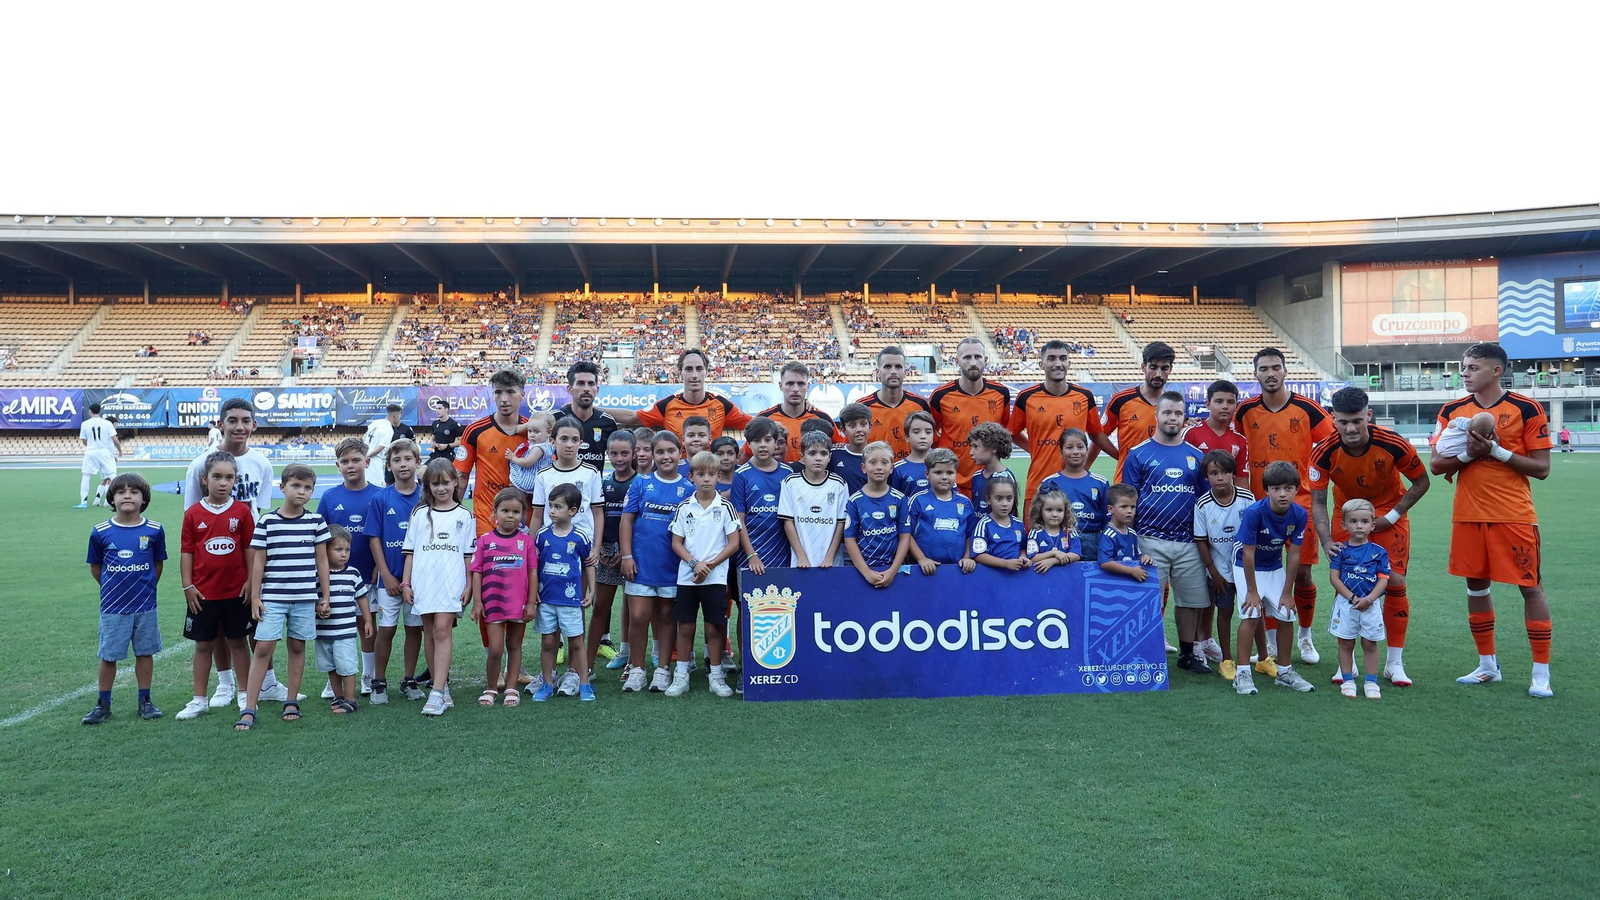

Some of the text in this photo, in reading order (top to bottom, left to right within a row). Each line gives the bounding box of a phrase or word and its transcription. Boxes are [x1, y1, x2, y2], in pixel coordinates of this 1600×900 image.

[1380, 318, 1460, 332] Cruzcampo
[178, 402, 219, 413] UNION
[92, 426, 101, 441] 11
[207, 543, 234, 551] LUGO
[1078, 663, 1167, 672] XEREZCLUBDEPORTIVO.ES
[749, 674, 799, 685] XEREZ CD
